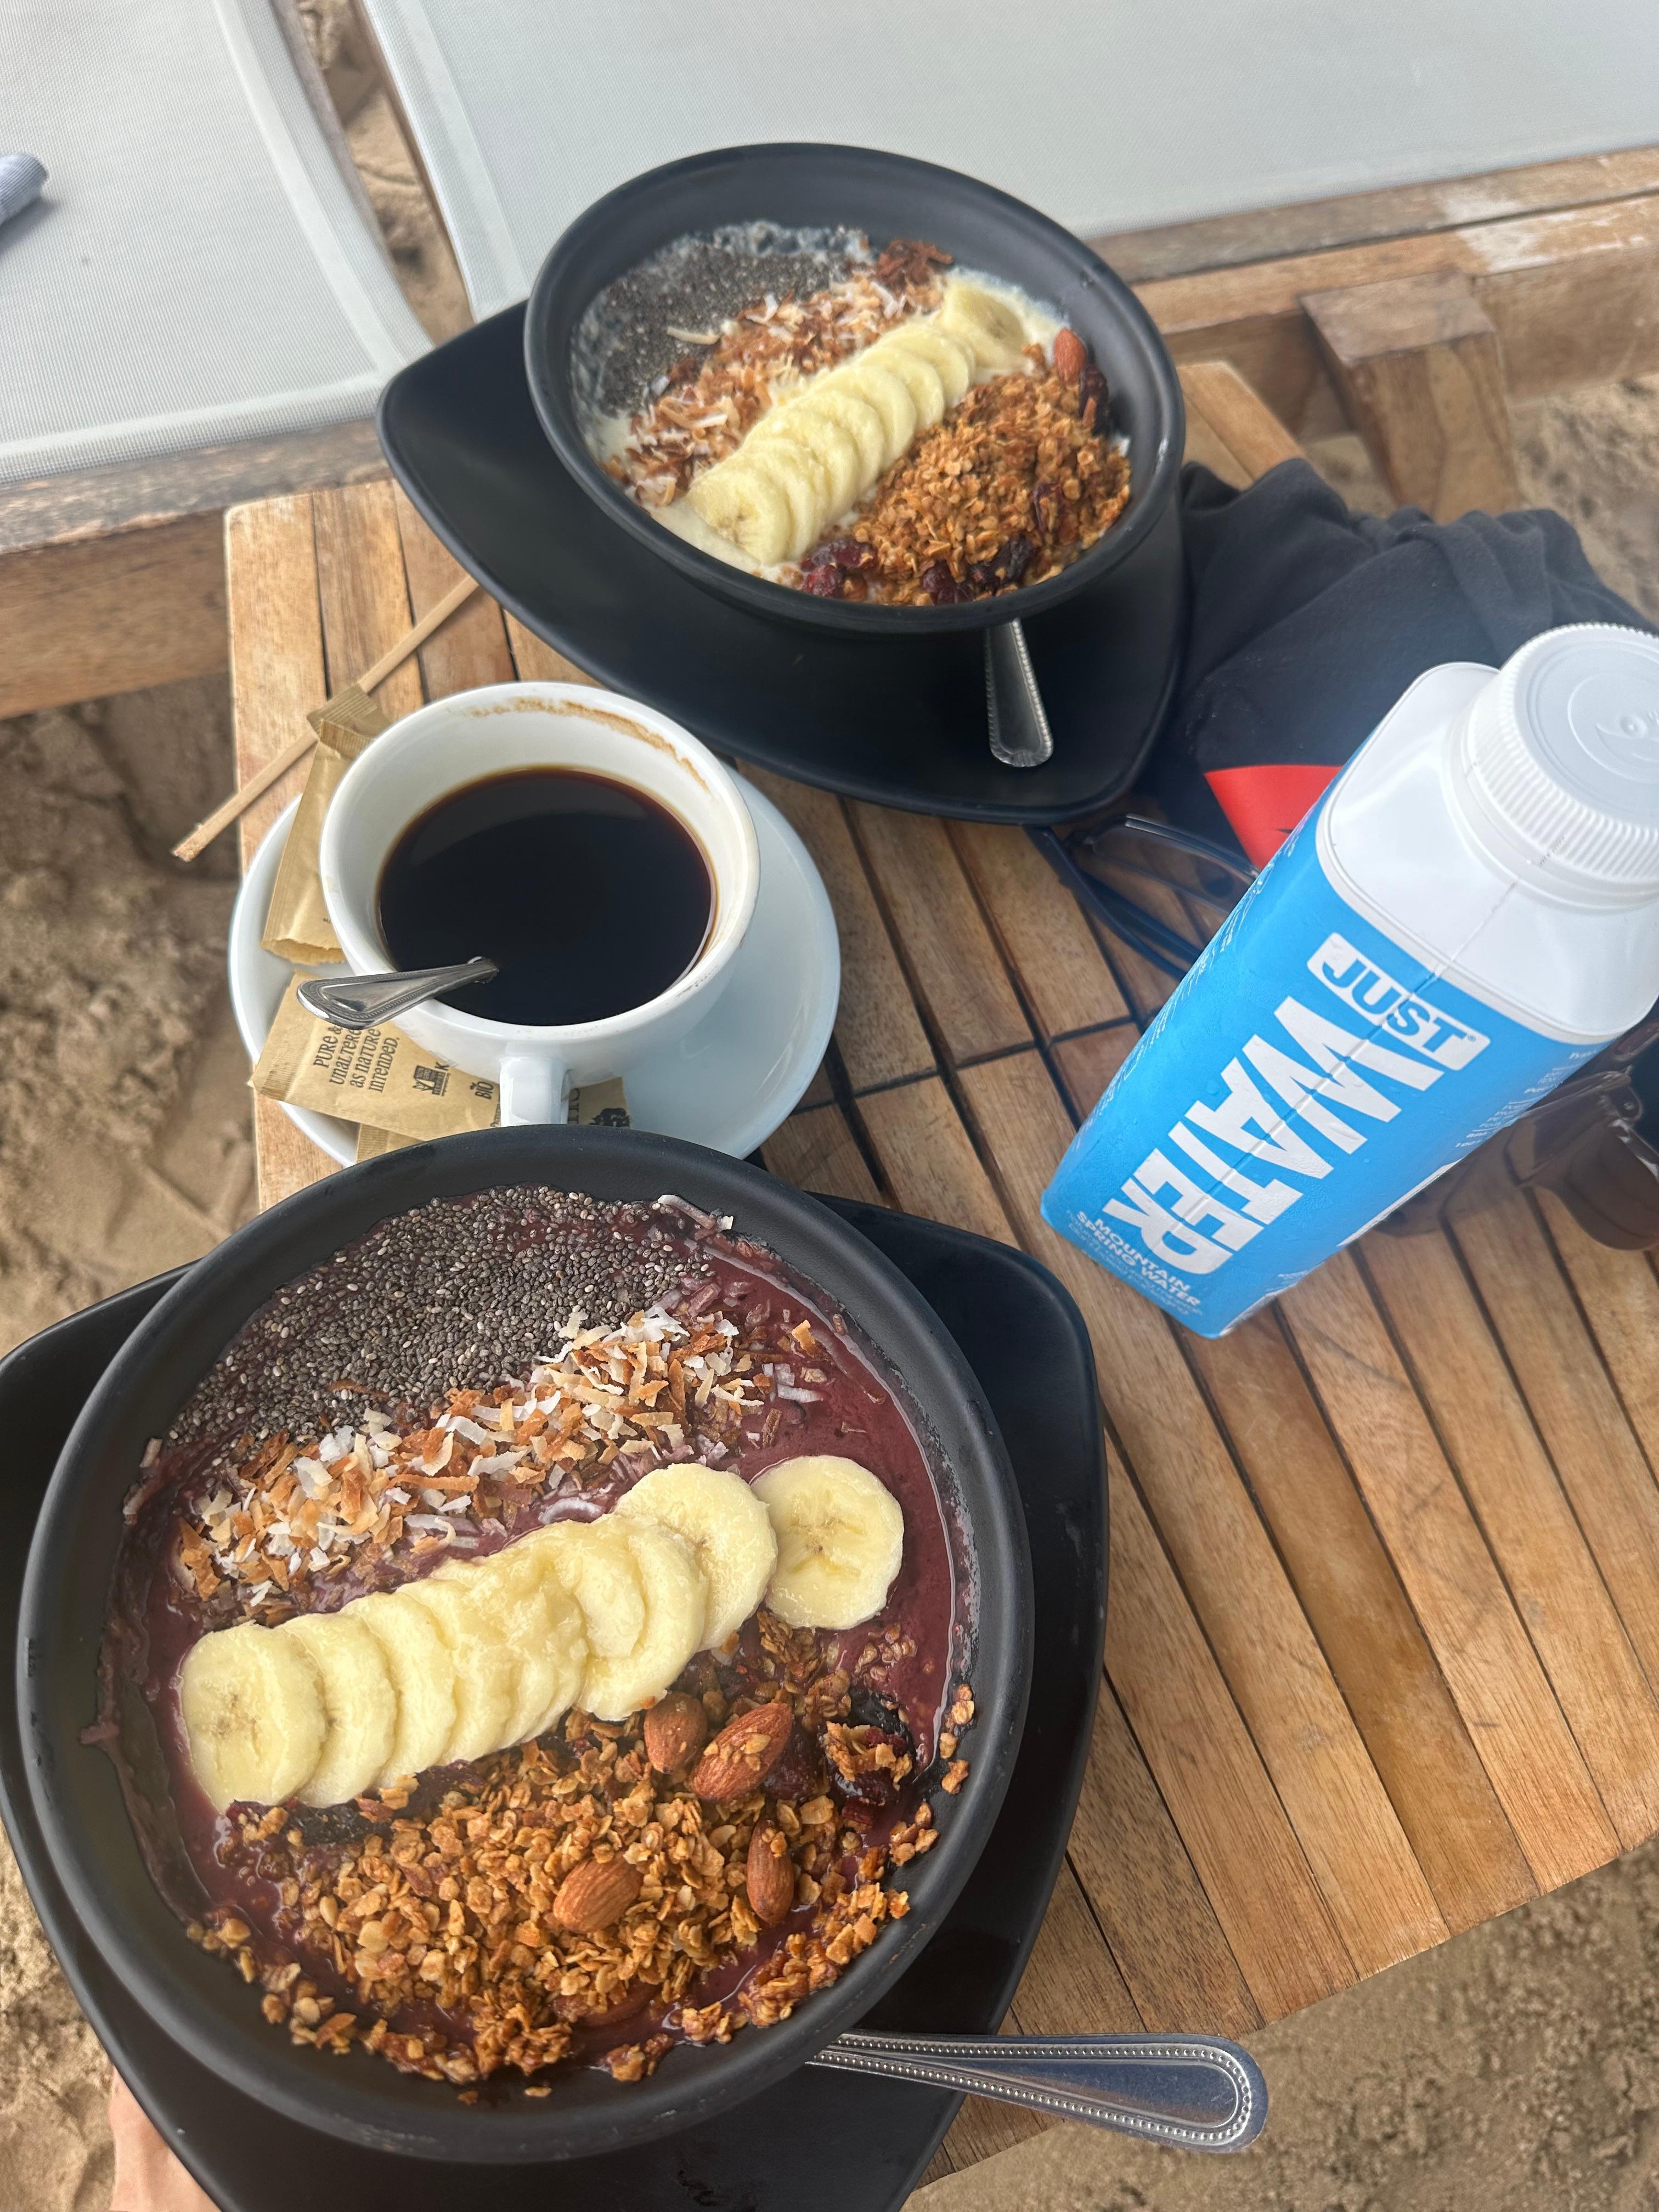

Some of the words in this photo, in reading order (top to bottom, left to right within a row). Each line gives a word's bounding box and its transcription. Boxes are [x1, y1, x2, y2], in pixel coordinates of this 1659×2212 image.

[328, 1026, 343, 1035] &
[475, 1081, 494, 1100] BIO
[1102, 996, 1444, 1274] WATER
[1077, 1211, 1136, 1266] SPRING
[1141, 1266, 1201, 1306] WATER
[1094, 1218, 1190, 1291] MOUNTAIN
